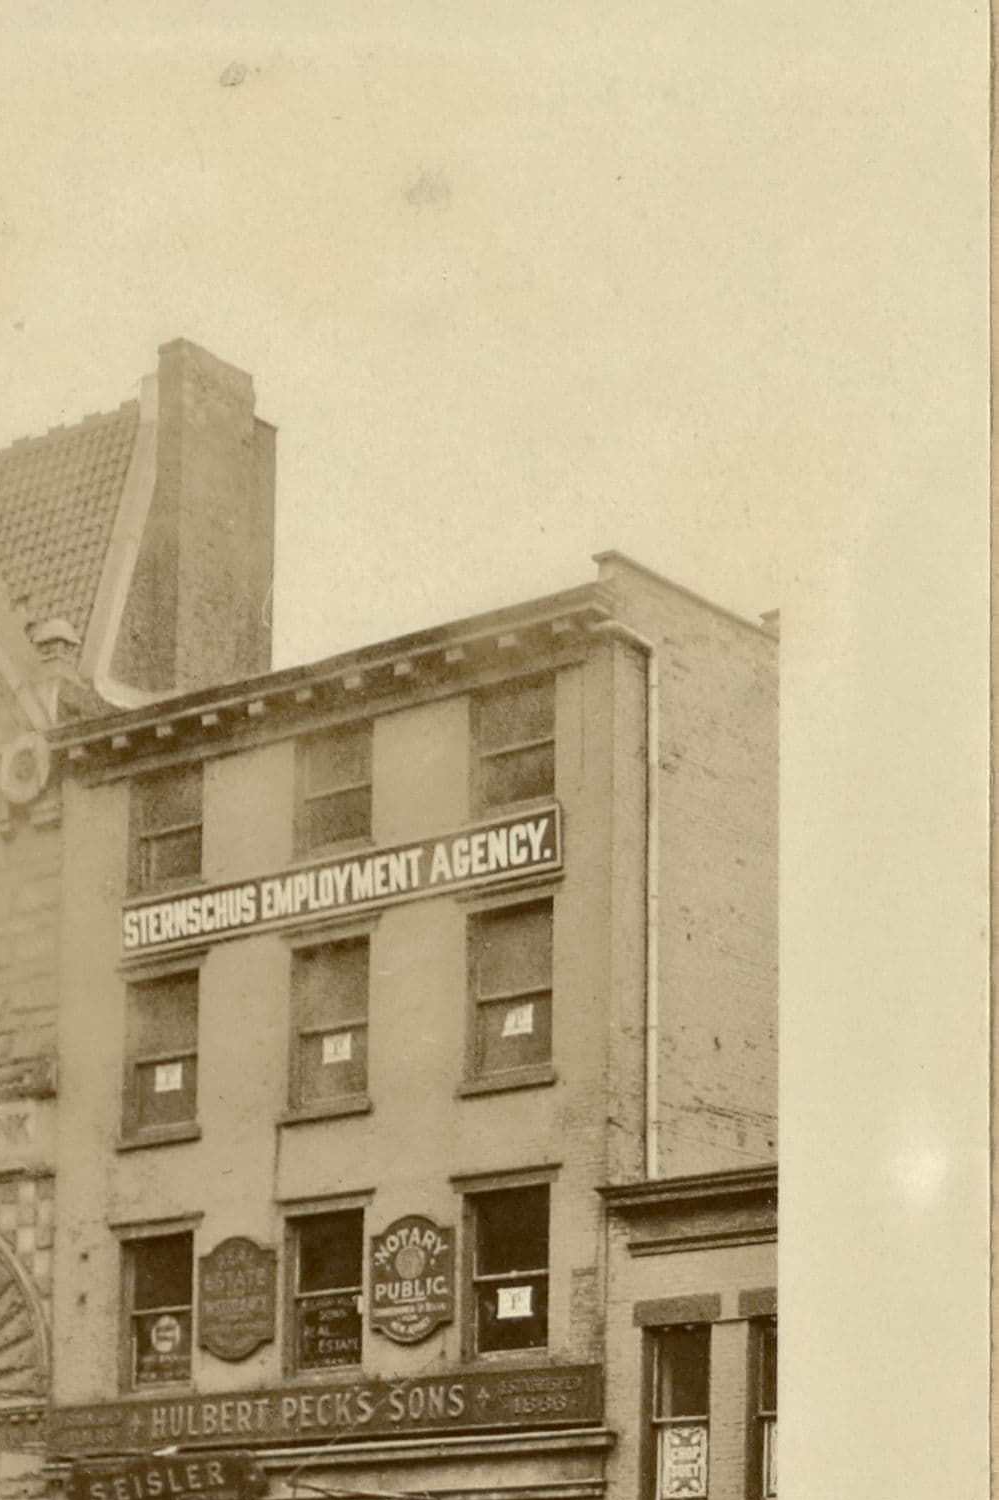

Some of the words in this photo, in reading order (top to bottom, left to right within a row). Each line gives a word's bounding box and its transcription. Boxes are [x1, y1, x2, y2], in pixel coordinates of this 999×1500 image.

[123, 887, 257, 948] STERNSCHUS
[261, 847, 424, 919] EMPLOYMENT
[374, 1227, 449, 1266] NOTARY
[151, 1399, 270, 1441] HULBERT
[281, 1386, 376, 1430] PECK'S
[387, 1383, 465, 1423] SONS
